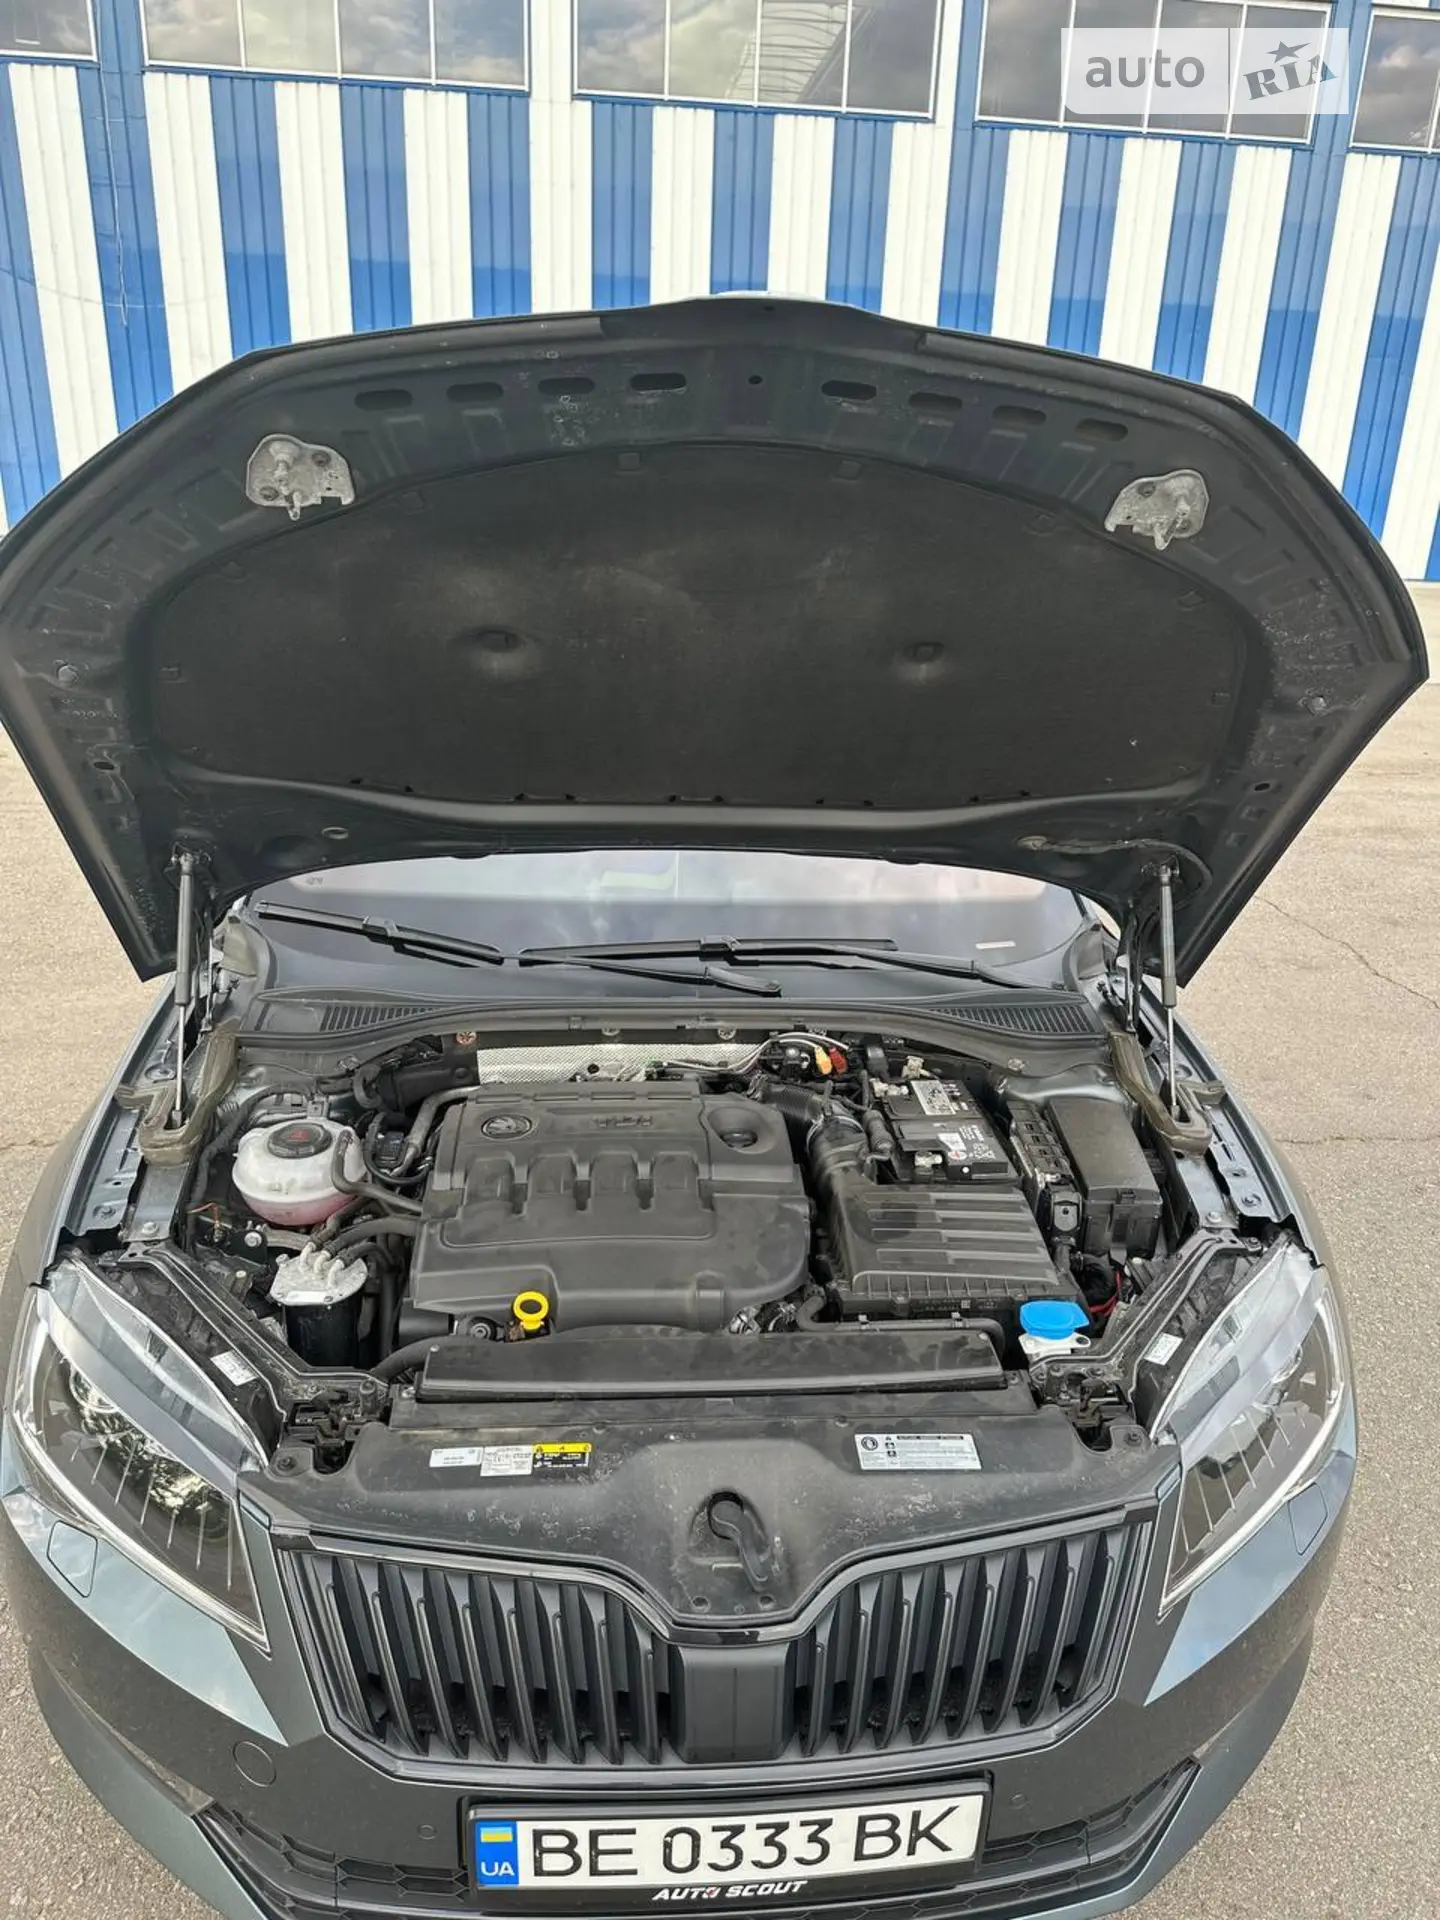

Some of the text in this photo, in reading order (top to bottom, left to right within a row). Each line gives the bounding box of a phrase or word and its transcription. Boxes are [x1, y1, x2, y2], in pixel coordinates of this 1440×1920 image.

[532, 1805, 960, 1877] BE 0333 BK
[480, 1861, 515, 1876] UA
[652, 1880, 808, 1901] AUTO SCOUT
